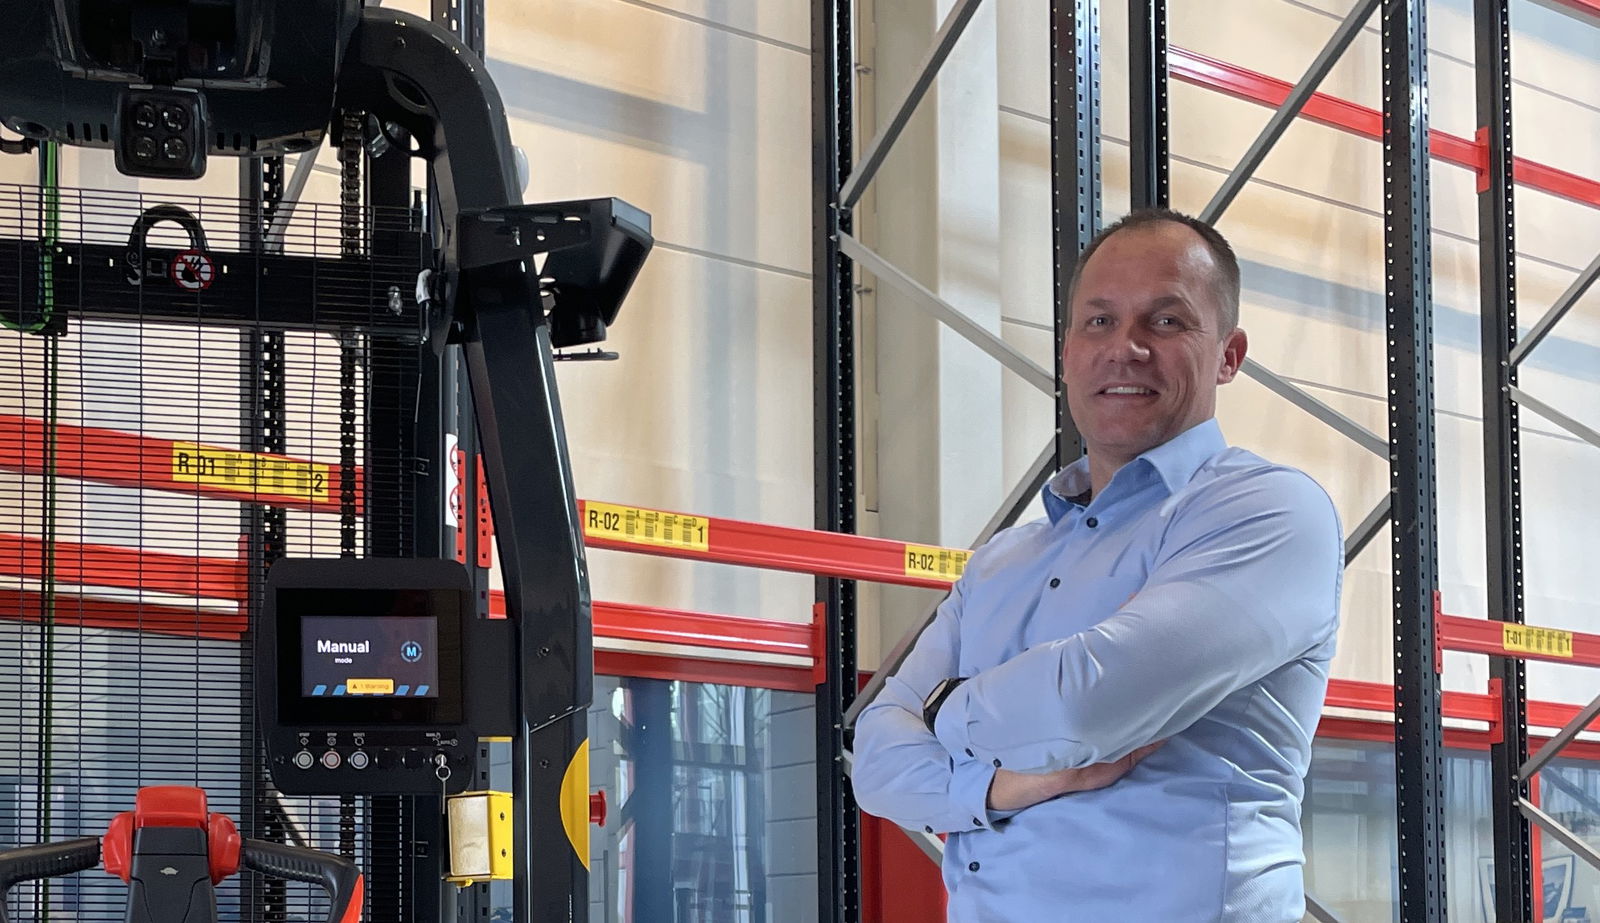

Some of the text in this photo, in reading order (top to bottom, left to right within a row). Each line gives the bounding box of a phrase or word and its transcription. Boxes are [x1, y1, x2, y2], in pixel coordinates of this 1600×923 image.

[179, 452, 214, 476] R01
[314, 473, 324, 493] 2
[589, 510, 620, 531] R-02
[698, 526, 703, 543] 1
[909, 552, 934, 571] R-02
[317, 639, 370, 653] Manual
[1505, 630, 1521, 645] T-01
[406, 646, 417, 657] M
